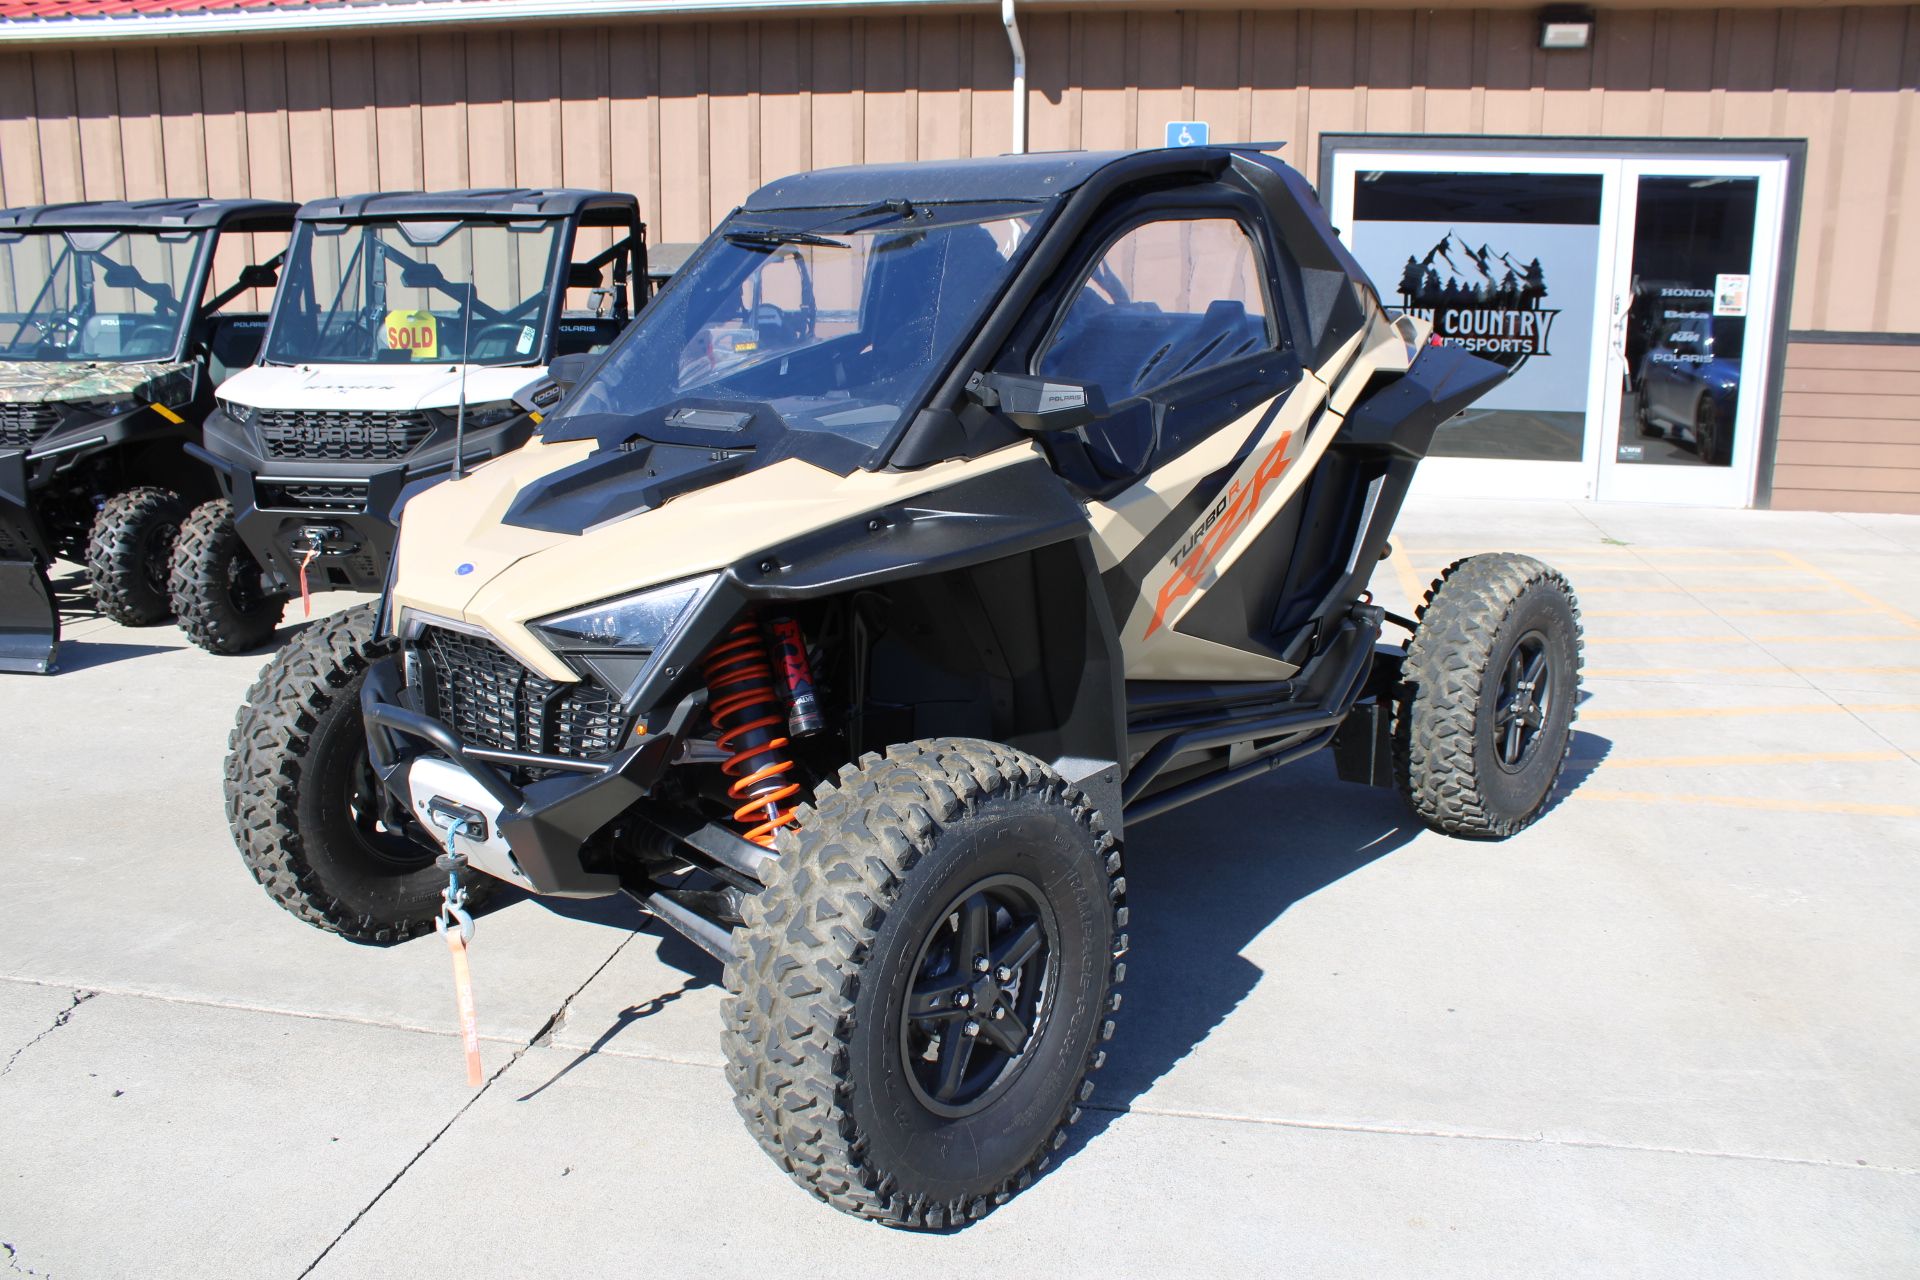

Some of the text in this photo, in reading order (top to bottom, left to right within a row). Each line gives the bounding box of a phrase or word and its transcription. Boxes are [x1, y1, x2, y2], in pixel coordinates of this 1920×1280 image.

[1661, 288, 1715, 298] HONDA
[1664, 310, 1710, 319] Beta
[388, 326, 434, 350] SOLD
[1444, 308, 1554, 355] COUNTRY
[1670, 331, 1700, 342] KTM
[1652, 353, 1714, 364] POLARIS
[534, 386, 560, 403] 1000
[1048, 394, 1082, 403] POLARIS
[280, 426, 389, 444] POLARIS
[1169, 478, 1241, 569] TURBO R
[1142, 430, 1293, 643] RZR
[773, 620, 815, 691] FOX
